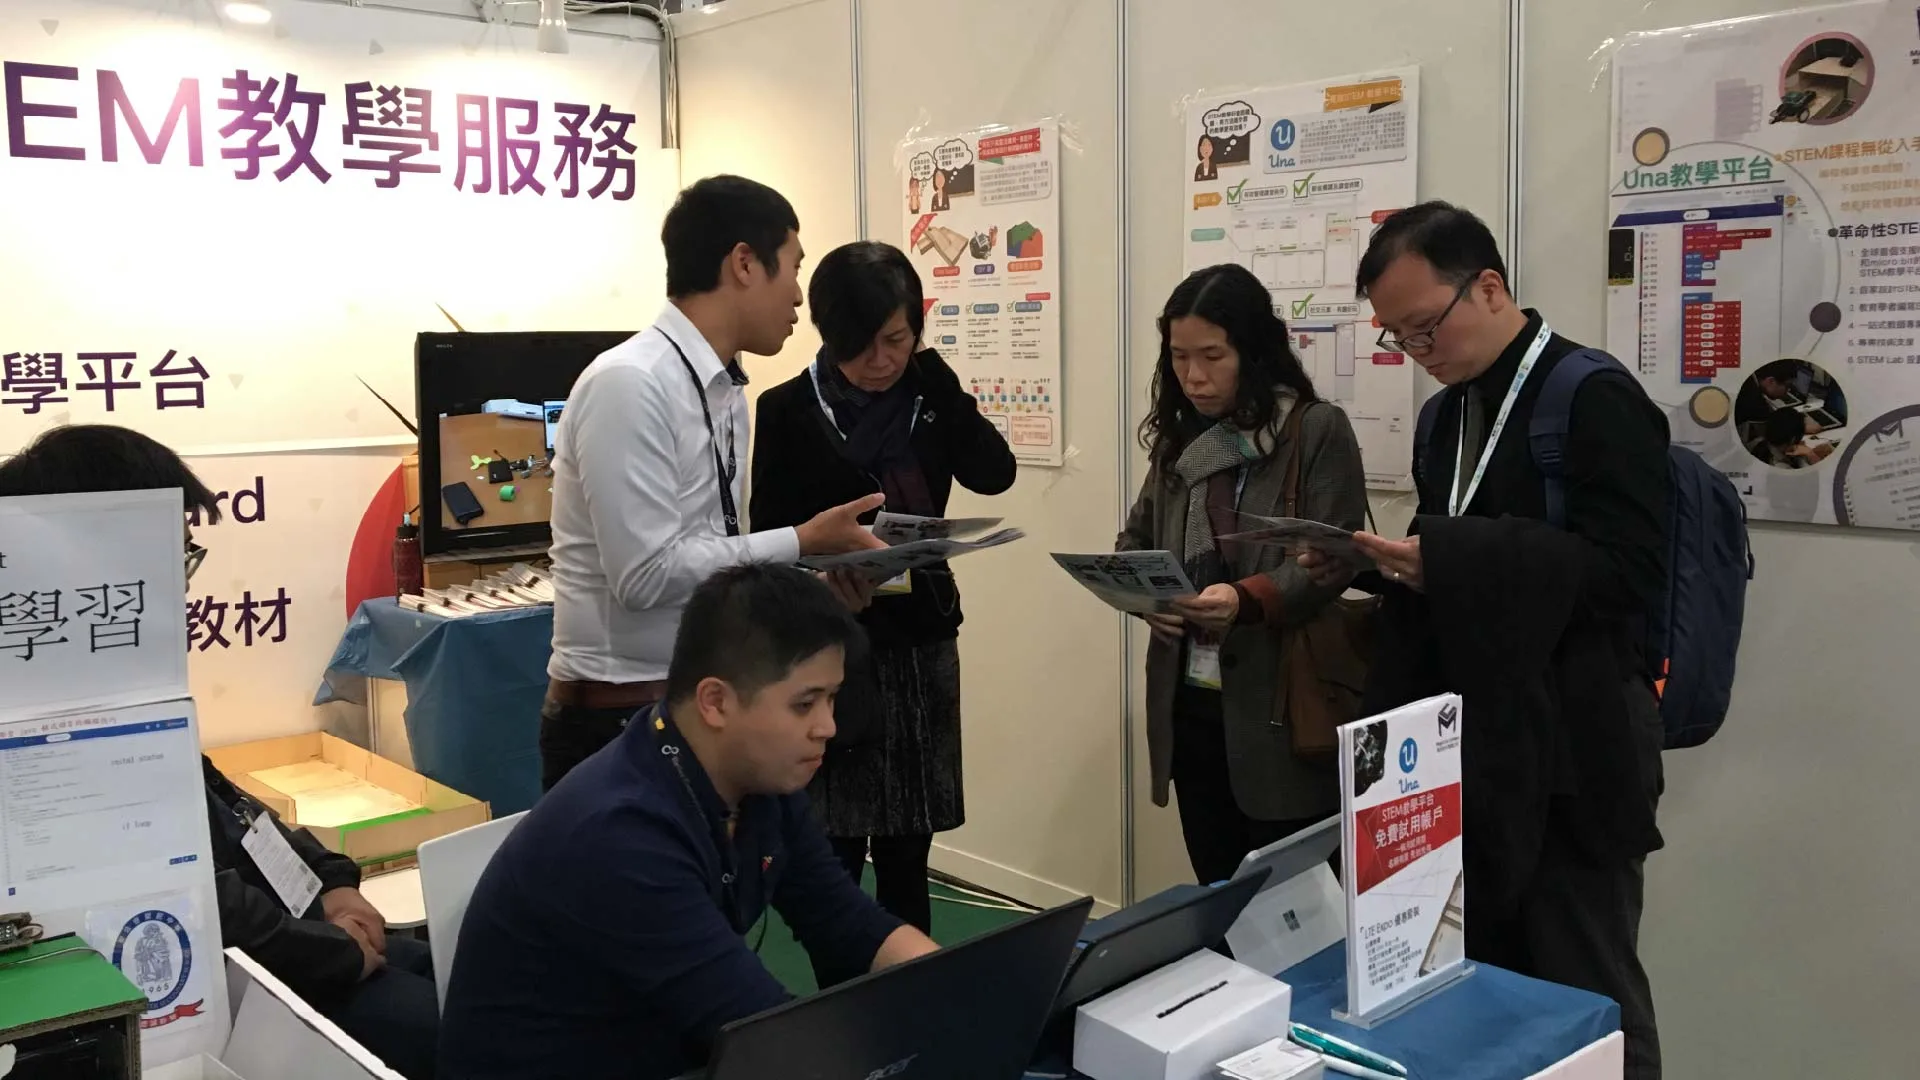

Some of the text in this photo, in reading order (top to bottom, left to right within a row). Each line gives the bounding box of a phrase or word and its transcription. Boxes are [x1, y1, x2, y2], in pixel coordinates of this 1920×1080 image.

[4, 60, 638, 201] EM教學服務
[1268, 154, 1296, 168] Una
[1624, 155, 1774, 189] Una教學平台
[1839, 222, 1920, 240] 革命性STE
[1, 350, 210, 413] 學平台
[0, 580, 146, 660] 學習
[186, 588, 291, 652] 教材
[1376, 806, 1443, 849] 免費試用帳戶
